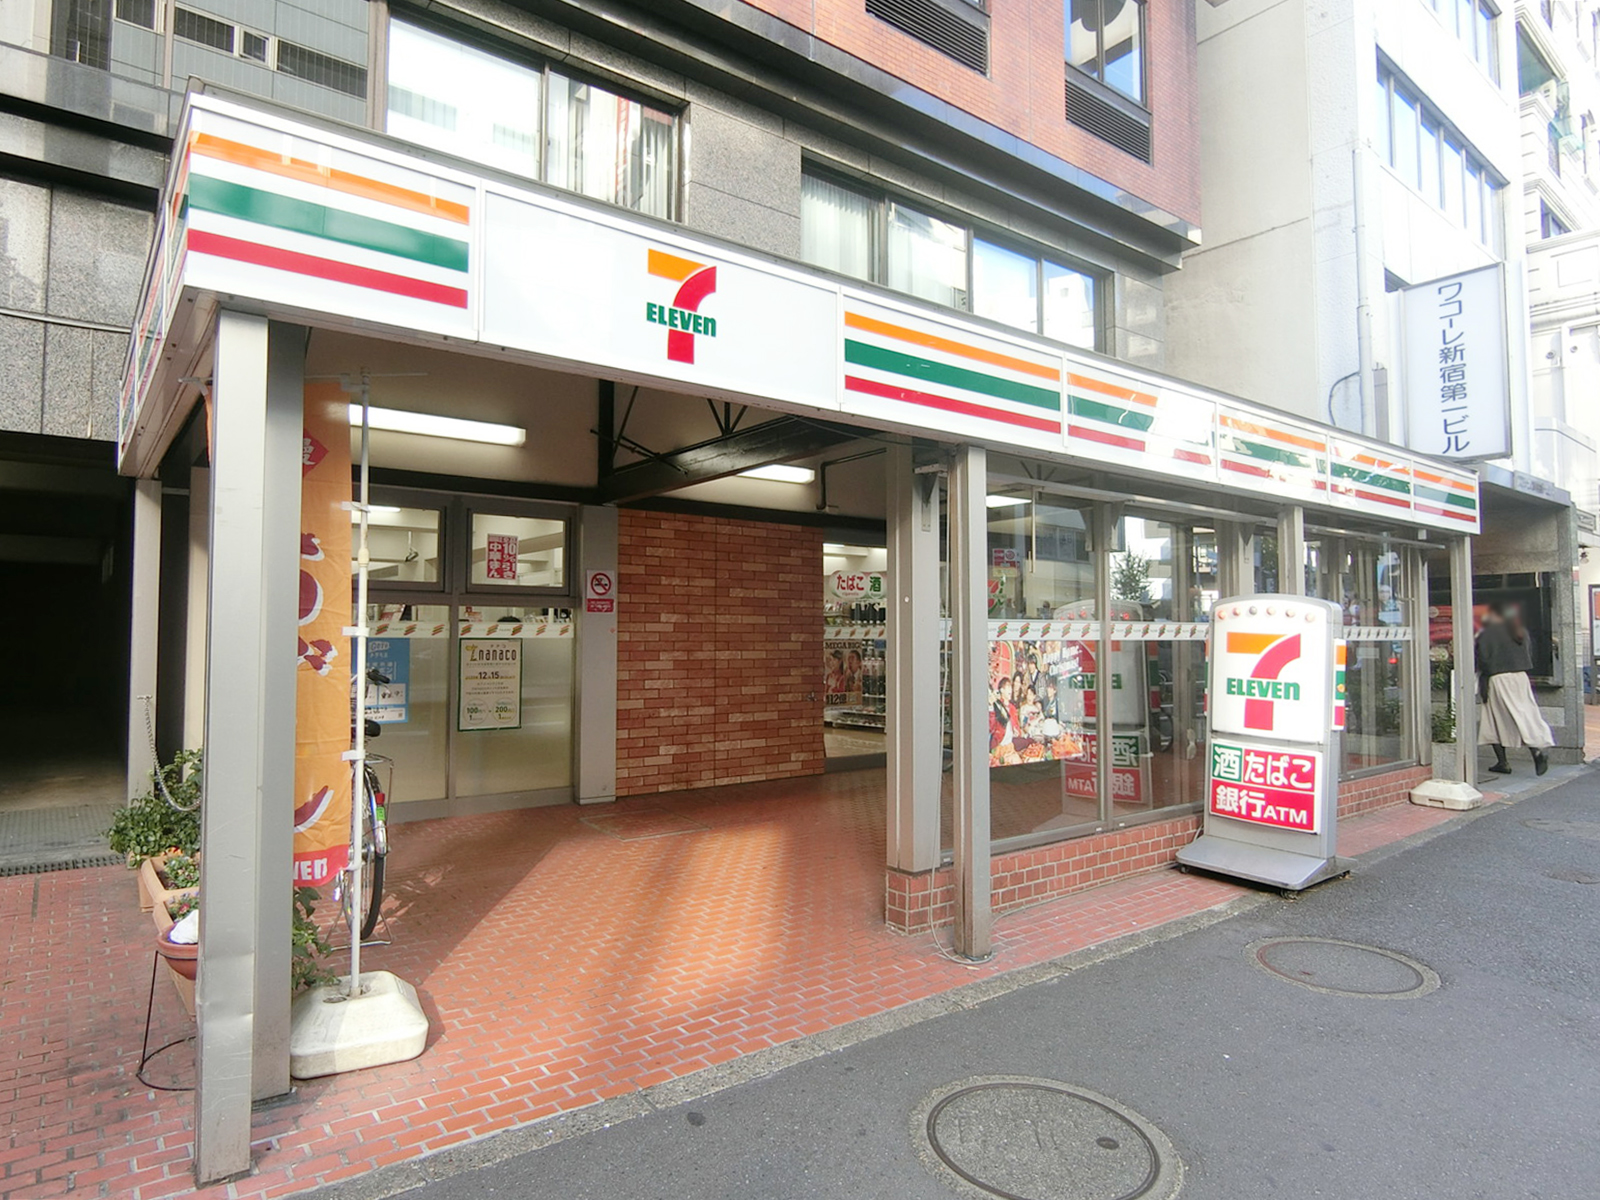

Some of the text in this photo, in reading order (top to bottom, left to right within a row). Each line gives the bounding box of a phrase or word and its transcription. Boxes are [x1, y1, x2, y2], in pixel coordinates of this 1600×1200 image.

[1437, 281, 1470, 454] ワコーレ新宿第一ビル
[489, 542, 502, 578] 中華まん
[837, 574, 882, 592] たばこ 酒
[478, 649, 517, 661] nanaco
[1214, 746, 1313, 789] 酒 たばこ
